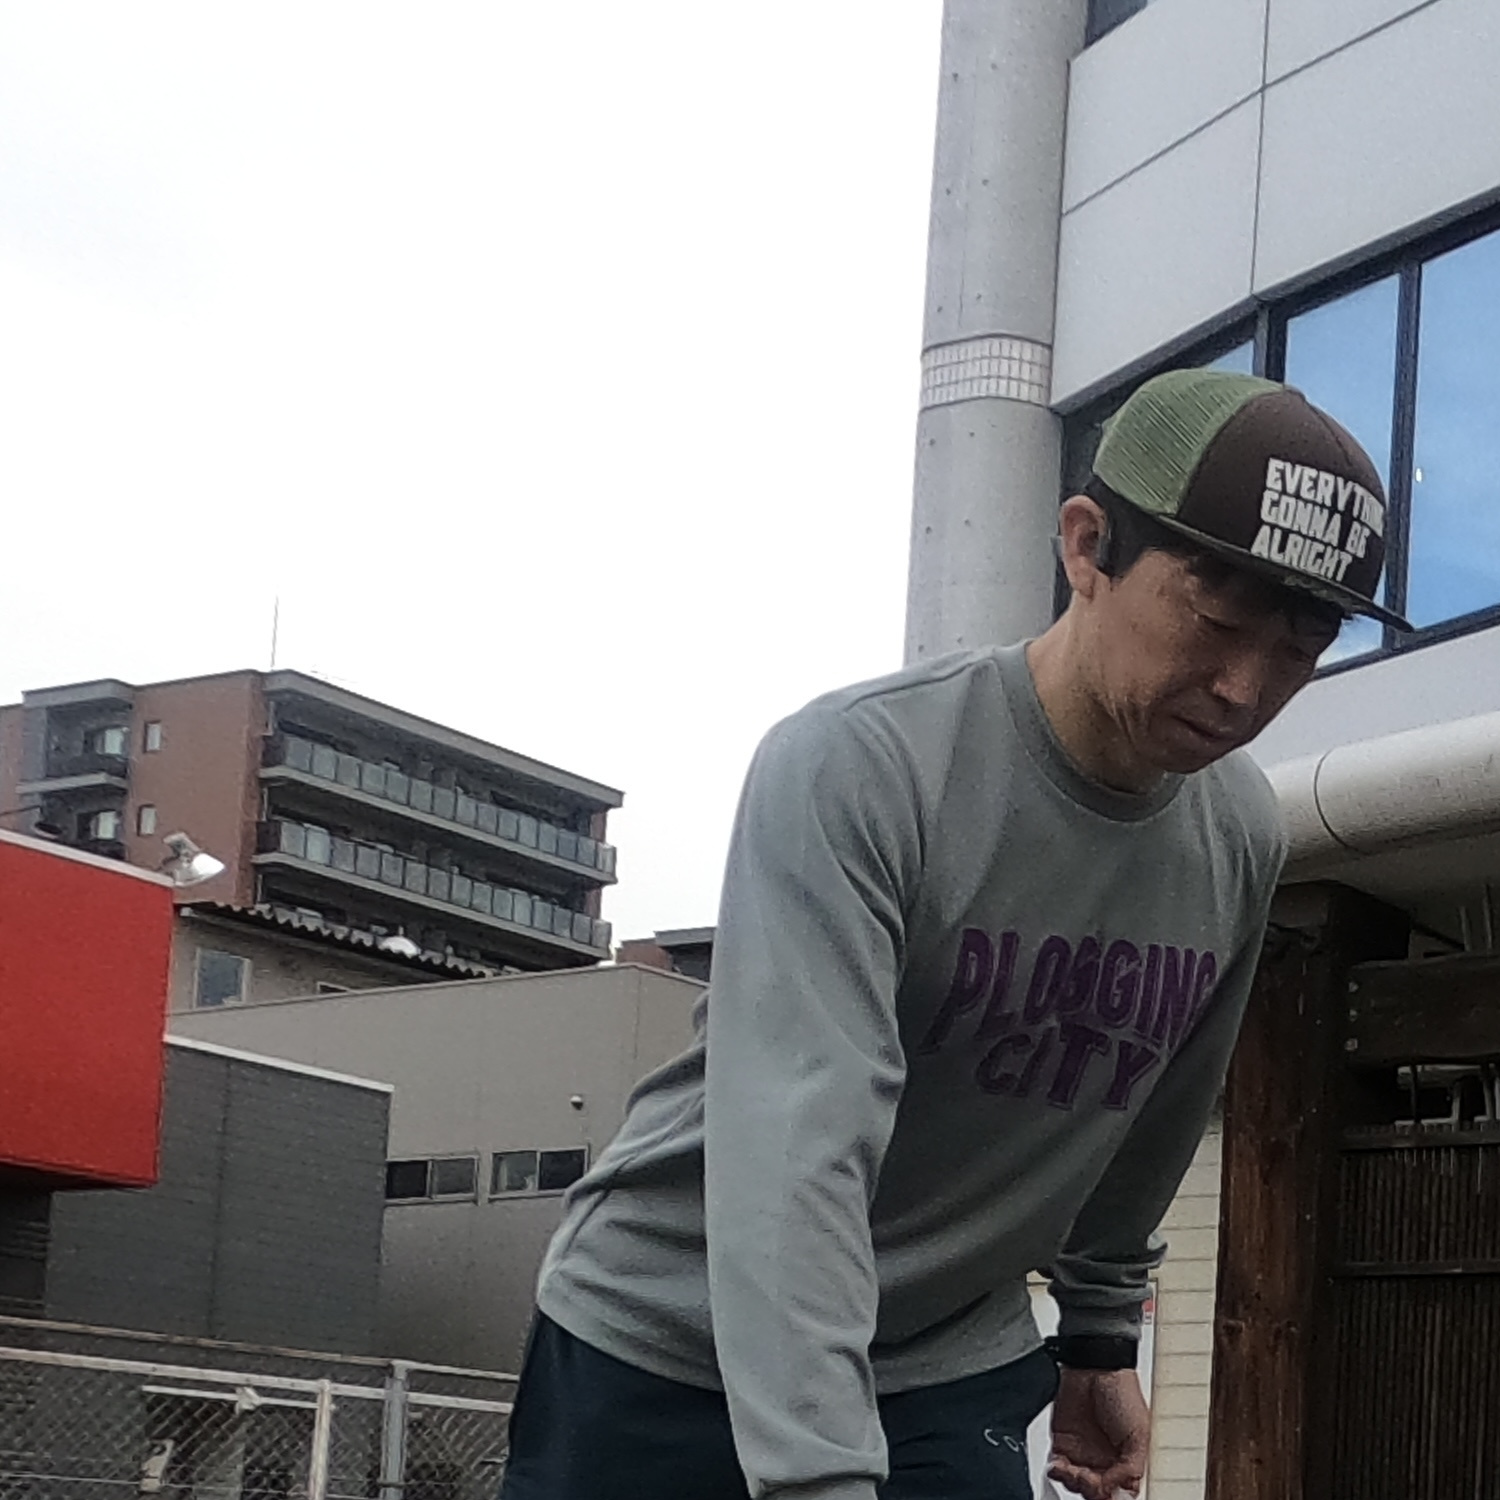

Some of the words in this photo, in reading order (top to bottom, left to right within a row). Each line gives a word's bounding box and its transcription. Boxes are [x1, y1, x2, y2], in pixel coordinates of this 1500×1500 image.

[1250, 524, 1354, 582] ALRIGHT
[1260, 489, 1342, 548] GONNA
[1345, 521, 1371, 559] BE
[975, 1022, 1161, 1111] CITY
